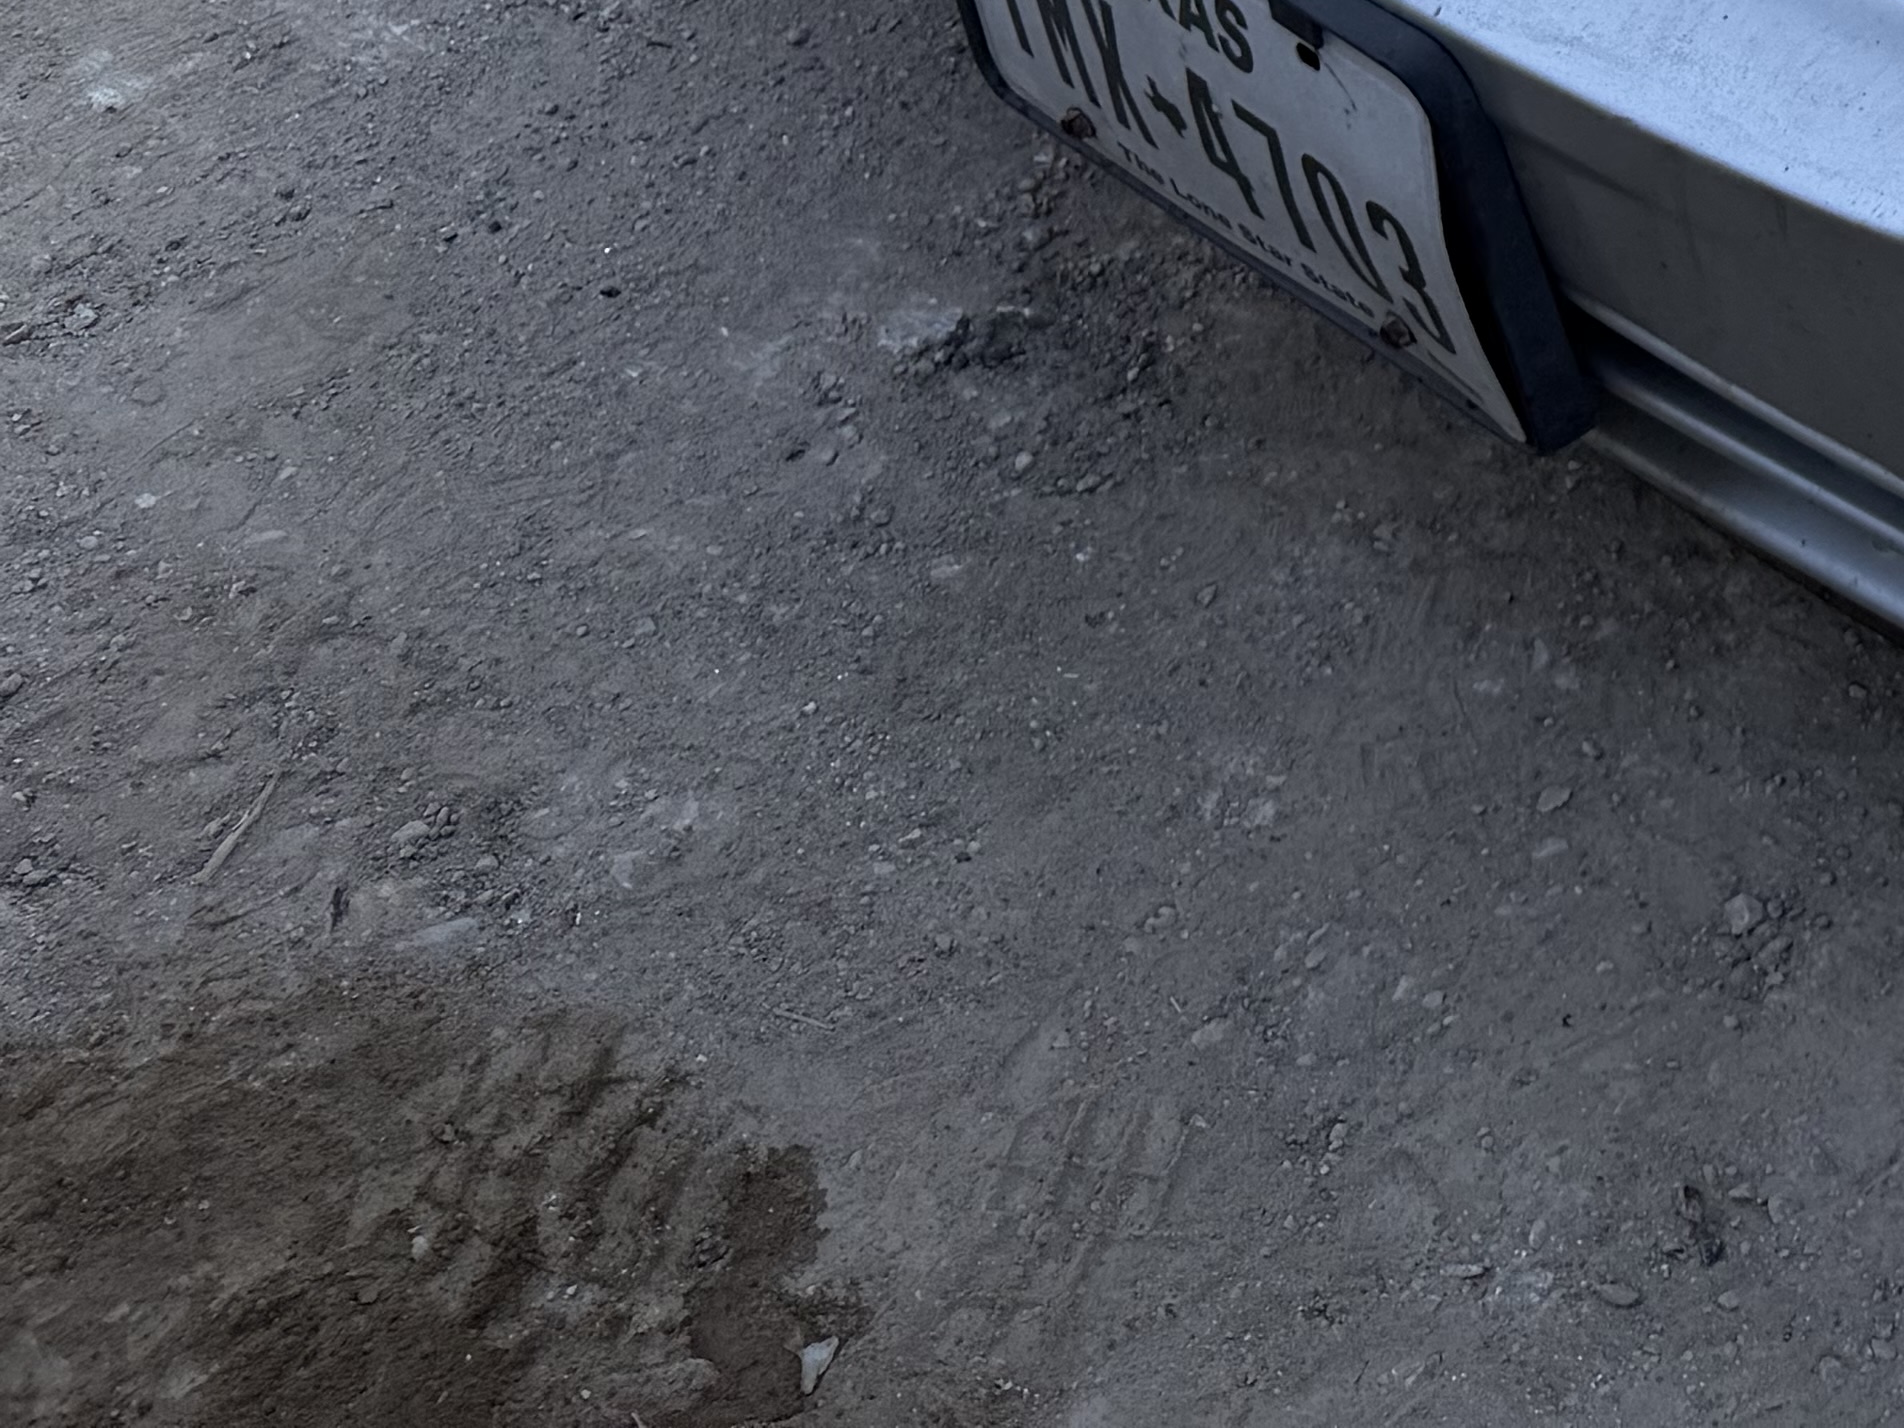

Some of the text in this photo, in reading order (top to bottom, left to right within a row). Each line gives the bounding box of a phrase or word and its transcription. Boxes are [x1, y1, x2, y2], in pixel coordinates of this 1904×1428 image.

[1116, 140, 1376, 318] The Lone Star State
[1184, 66, 1457, 355] 4703
